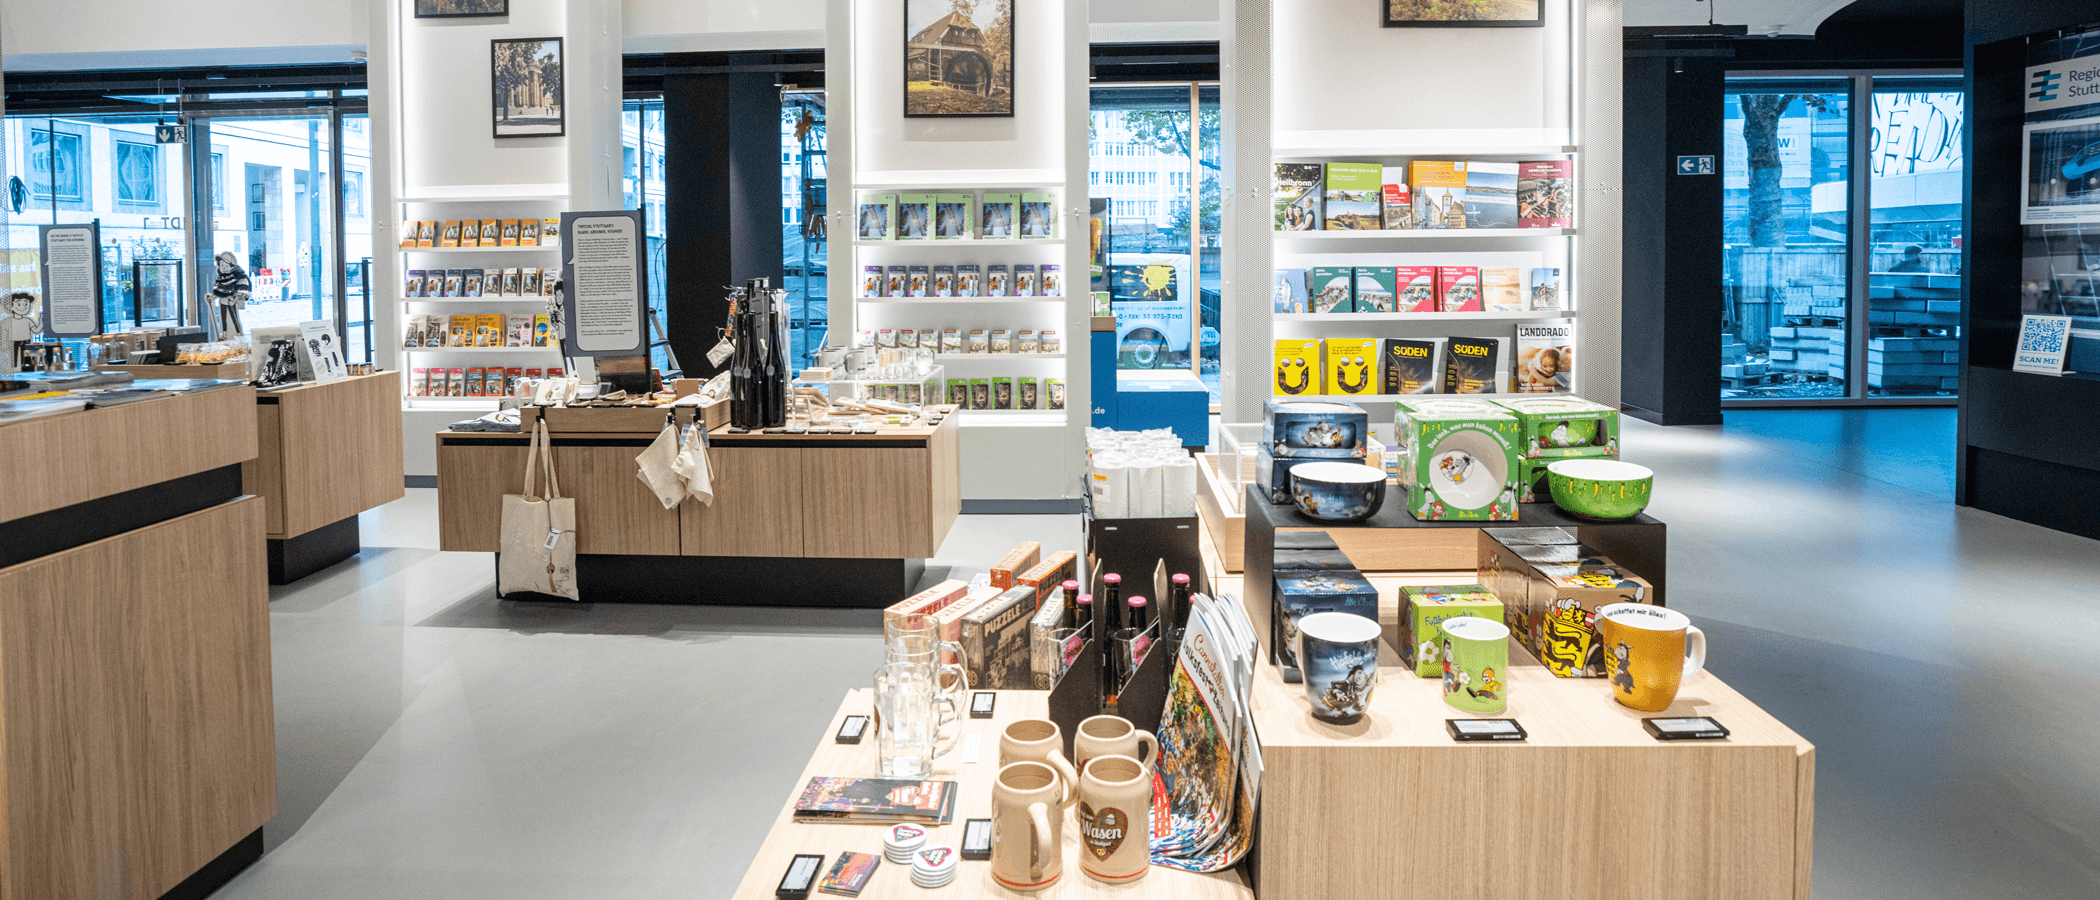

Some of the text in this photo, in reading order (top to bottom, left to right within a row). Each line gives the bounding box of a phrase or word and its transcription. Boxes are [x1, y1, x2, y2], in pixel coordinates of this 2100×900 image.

[1277, 179, 1313, 187] Heilbronn
[1520, 327, 1569, 337] LANDORADO
[1394, 345, 1428, 357] SÜDEN
[1454, 344, 1488, 356] SÜDEN
[2019, 355, 2059, 365] SCAN ME!
[1091, 406, 1105, 414] .de
[891, 590, 940, 611] PUZZELE
[984, 603, 1020, 637] PUZZELE
[1081, 818, 1122, 839] Wasen
